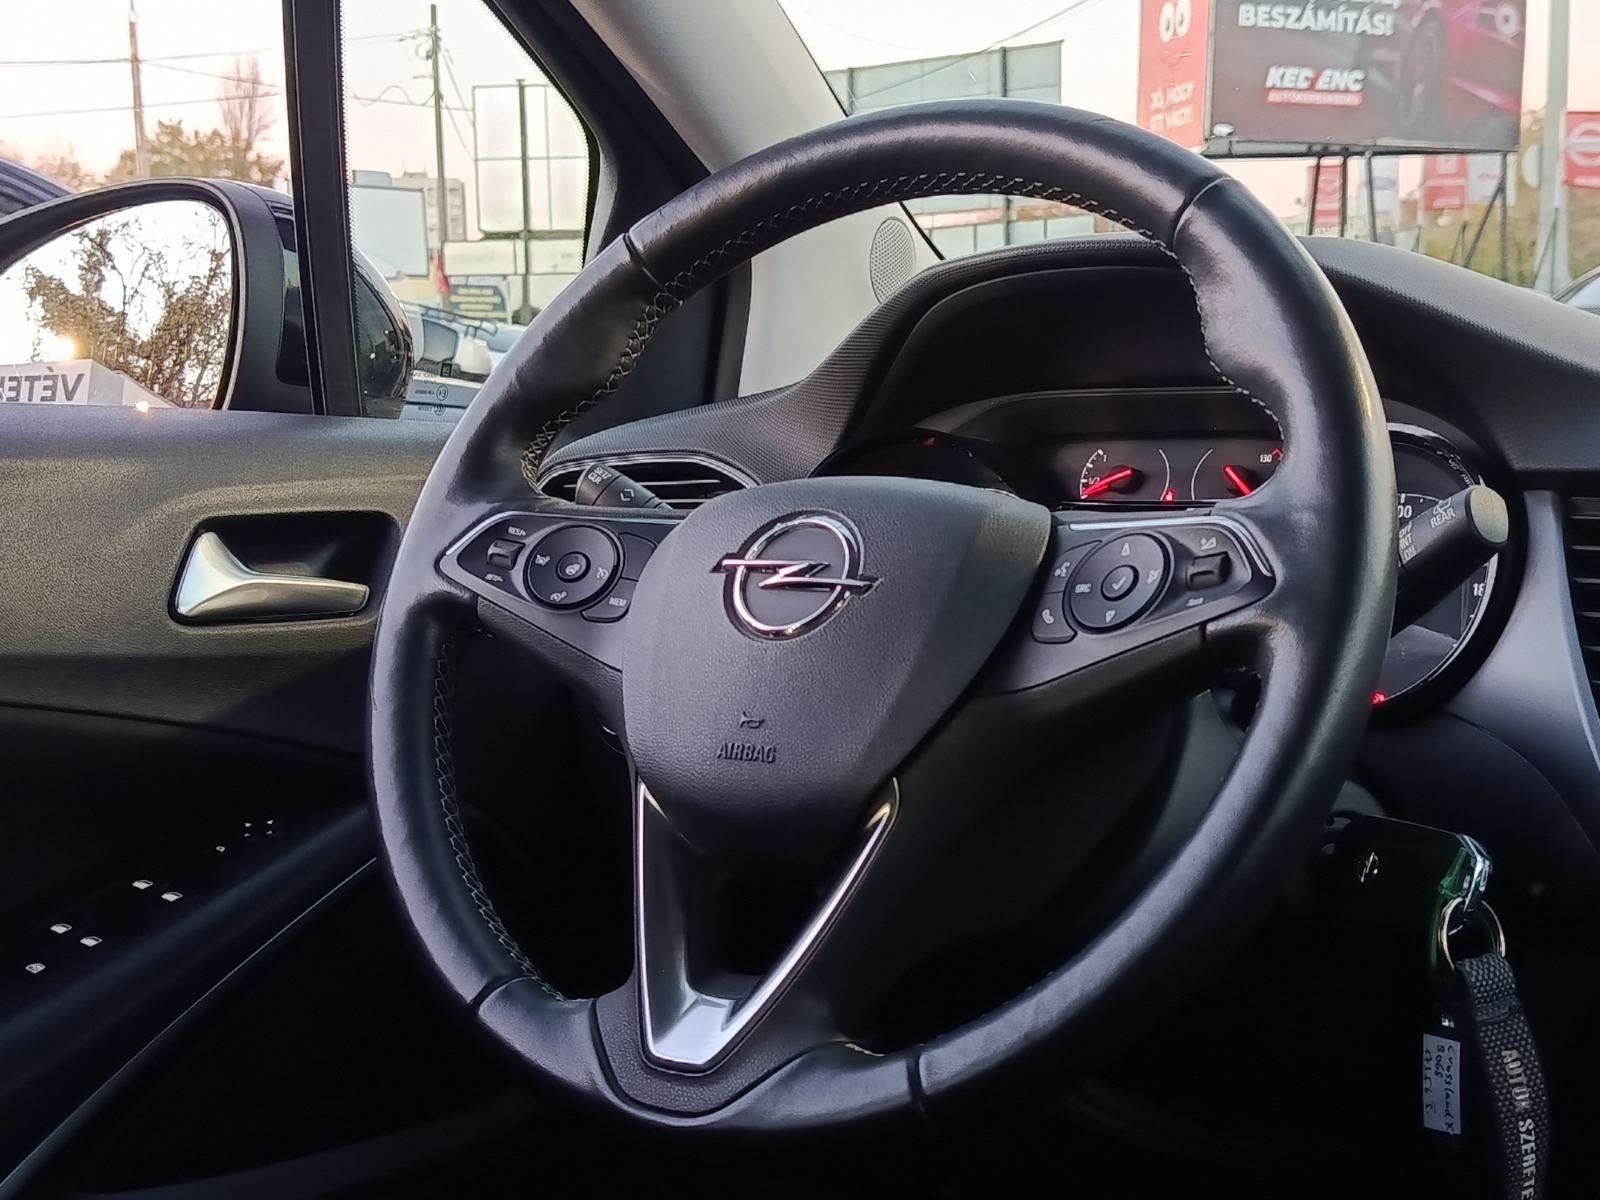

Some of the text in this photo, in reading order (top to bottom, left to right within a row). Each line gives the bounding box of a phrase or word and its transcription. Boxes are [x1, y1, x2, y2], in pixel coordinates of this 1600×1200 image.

[1259, 454, 1272, 463] 130
[1430, 508, 1456, 528] REAR
[717, 742, 777, 764] AIRBAG
